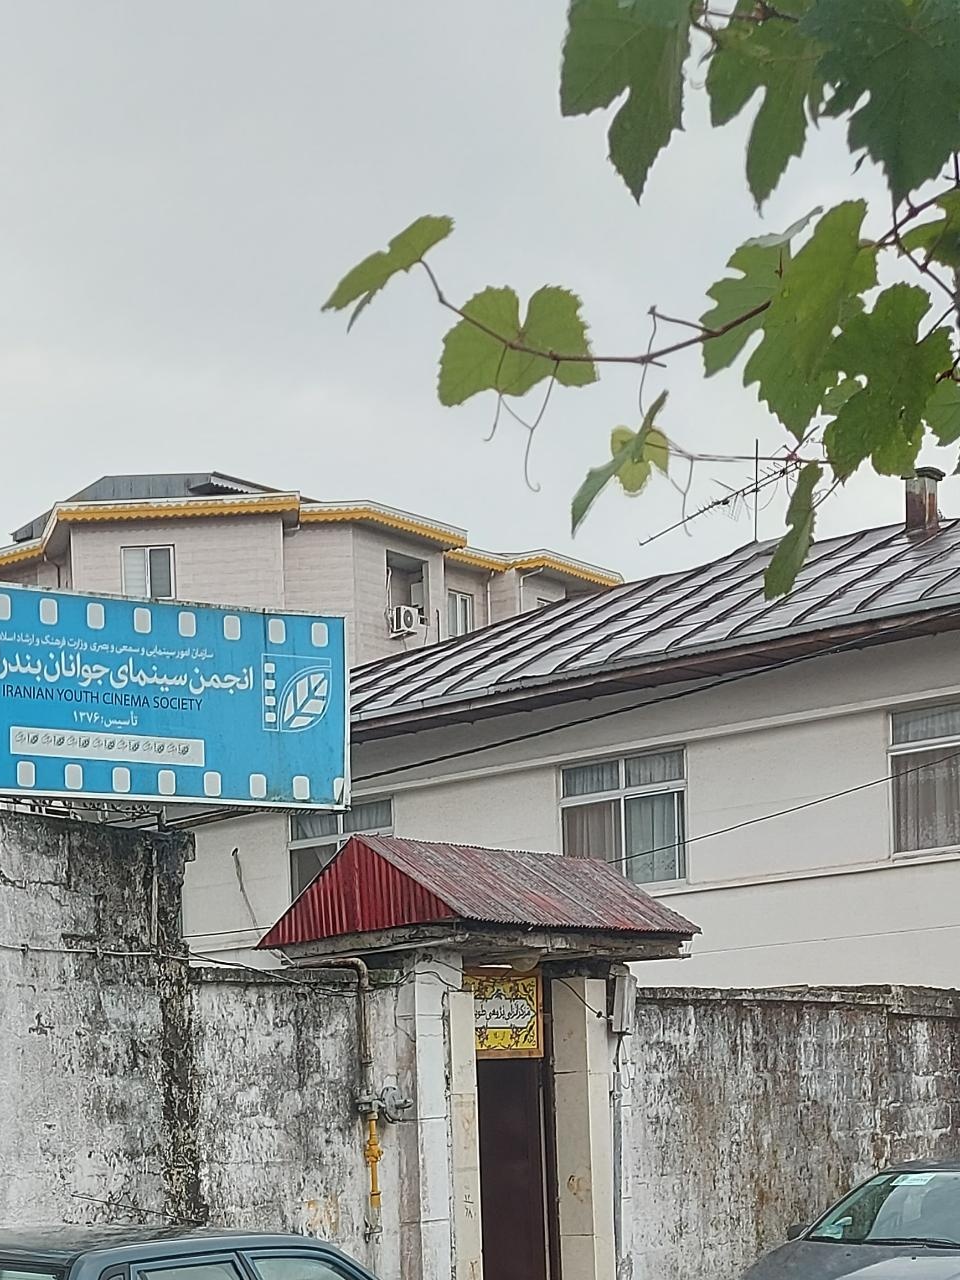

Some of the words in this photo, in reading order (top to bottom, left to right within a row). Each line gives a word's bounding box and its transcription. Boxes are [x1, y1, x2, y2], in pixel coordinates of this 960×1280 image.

[16, 632, 35, 645] ارشاد
[41, 635, 66, 649] فرهنگ
[67, 637, 88, 651] وزارت
[90, 641, 109, 653] بصری
[115, 644, 140, 654] سمعی
[176, 647, 191, 659] امور
[191, 648, 214, 660] سازمان
[43, 650, 110, 687] جوانان
[109, 656, 188, 692] سینمای
[188, 665, 254, 695] انجمن
[2, 683, 54, 700] IRANIAN
[57, 688, 98, 704] YOUTH
[103, 692, 150, 709] CINEMA
[153, 696, 203, 712] SOCIETY
